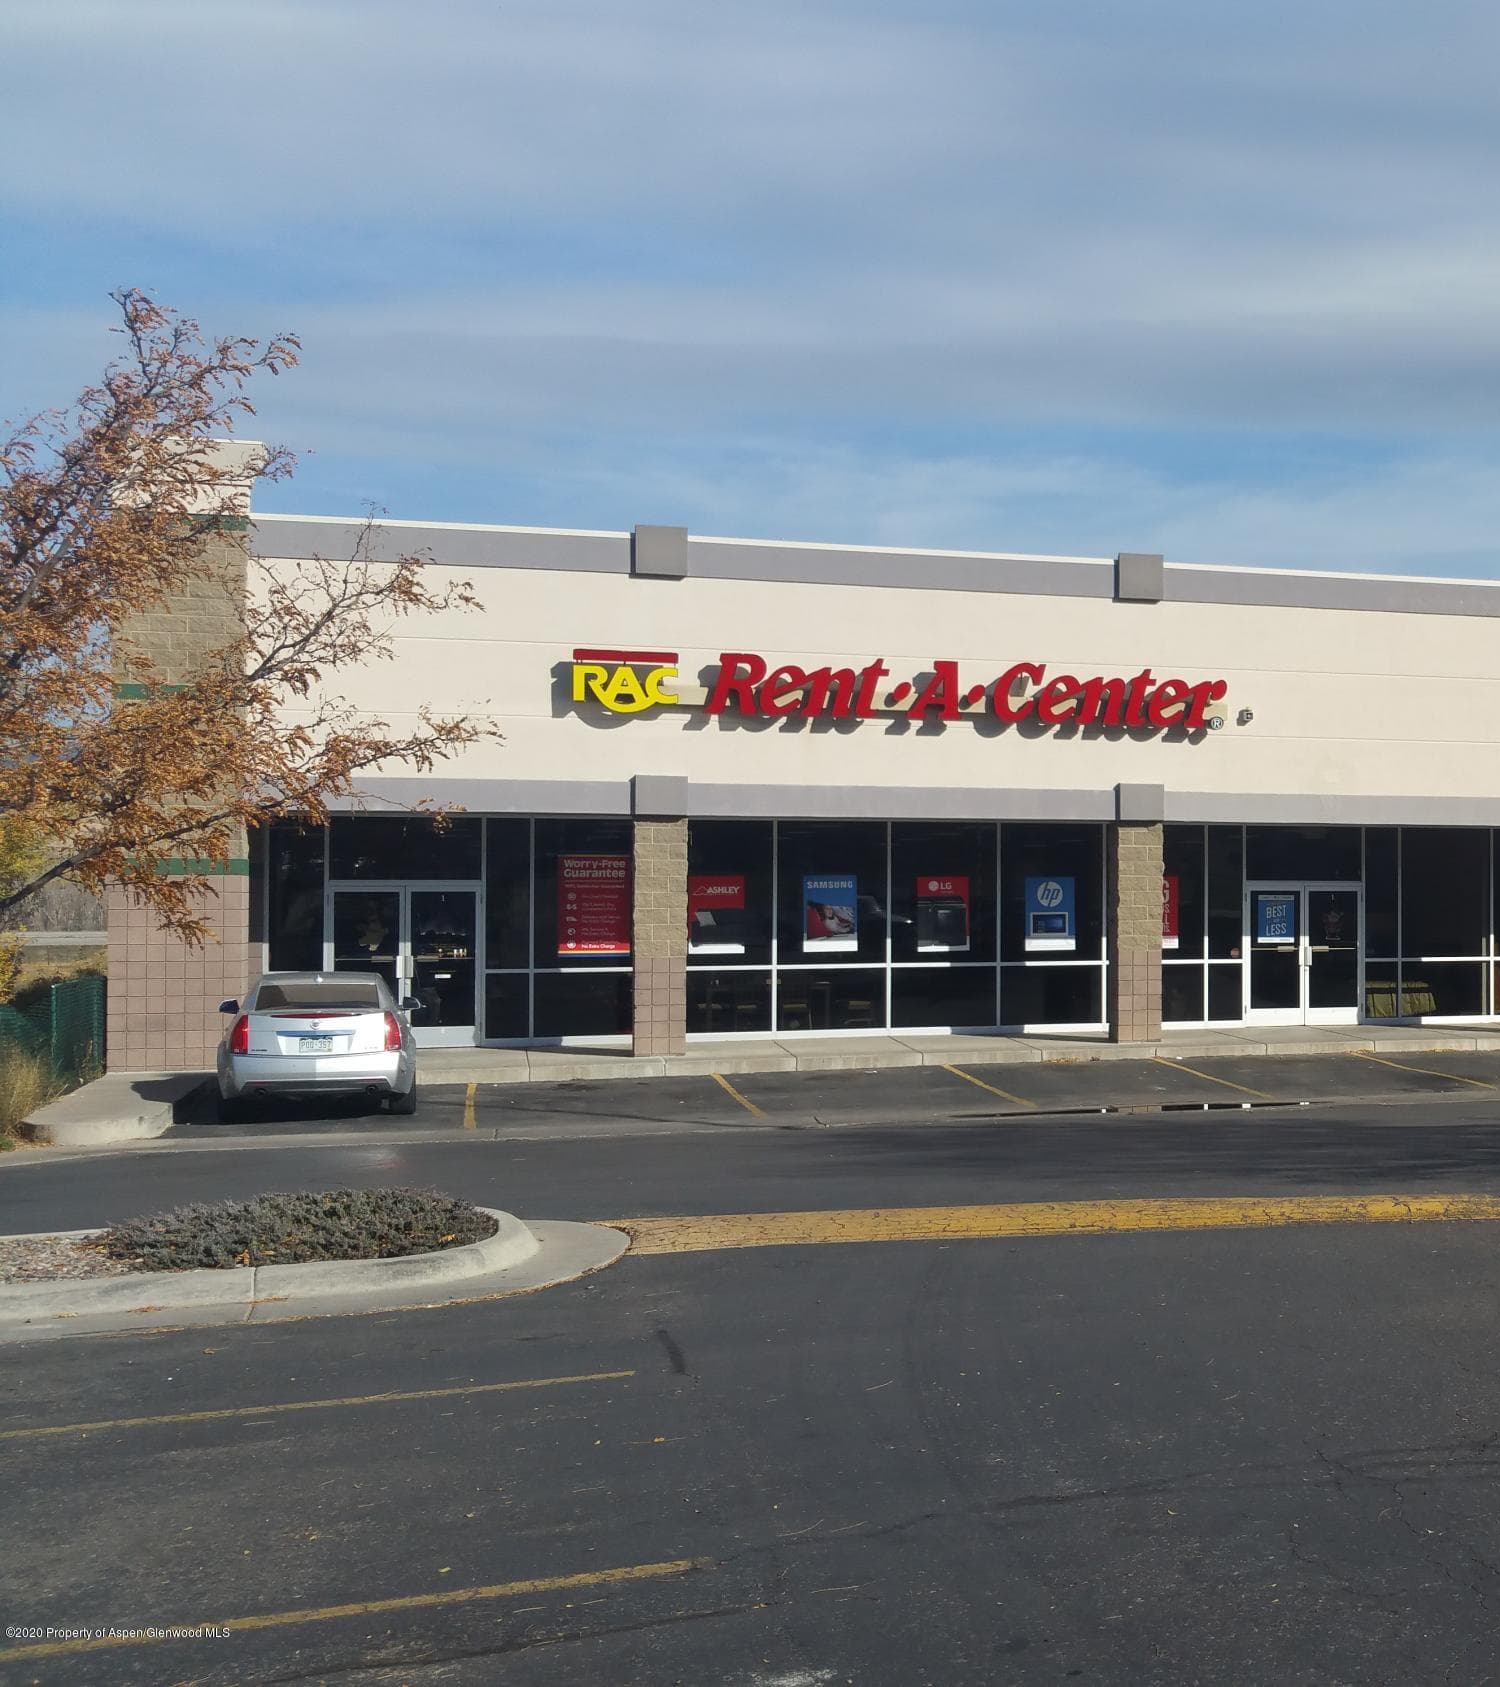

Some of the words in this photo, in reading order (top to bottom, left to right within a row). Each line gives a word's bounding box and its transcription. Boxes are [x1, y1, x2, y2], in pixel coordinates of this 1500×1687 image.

[573, 664, 679, 713] RAC
[563, 859, 626, 869] Worry-Free
[563, 868, 626, 878] Guarantee
[807, 880, 853, 889] SAMSUNG
[940, 882, 952, 890] LG
[706, 886, 740, 894] ASHLEY
[1040, 882, 1061, 908] hp
[1266, 905, 1287, 919] BEST
[1265, 922, 1287, 937] LESS
